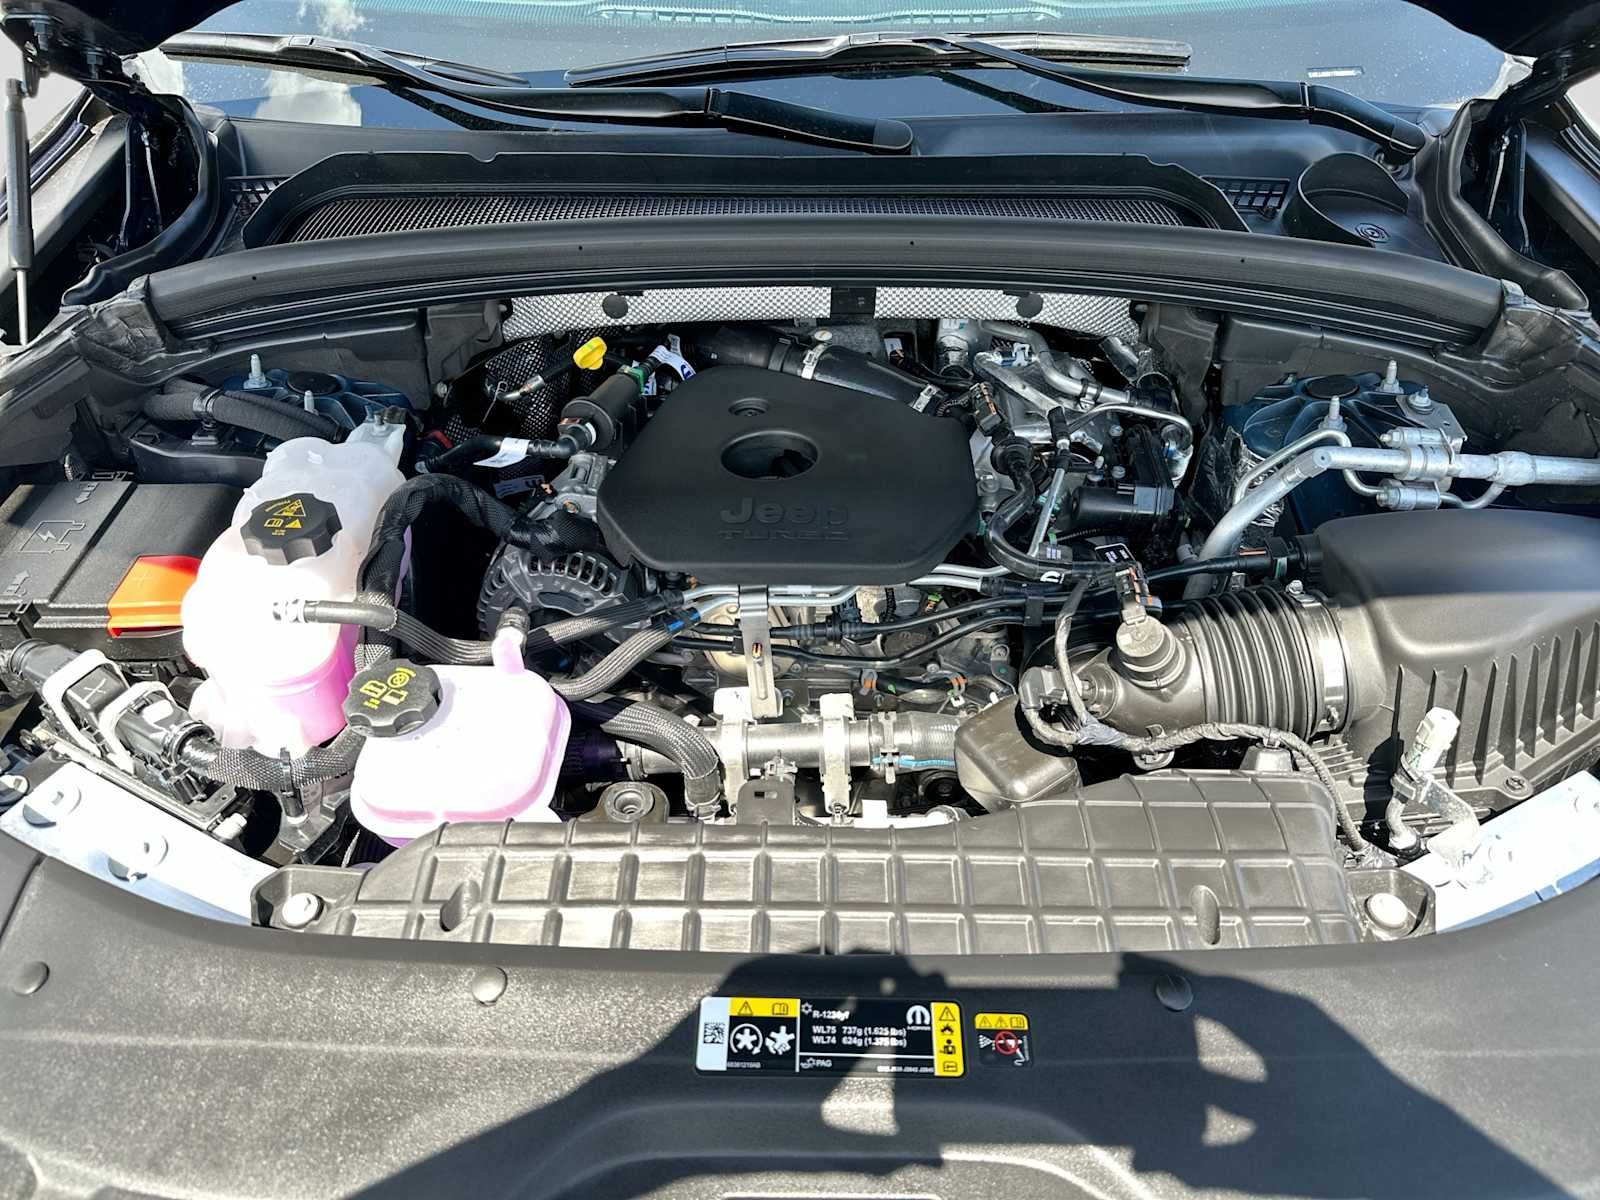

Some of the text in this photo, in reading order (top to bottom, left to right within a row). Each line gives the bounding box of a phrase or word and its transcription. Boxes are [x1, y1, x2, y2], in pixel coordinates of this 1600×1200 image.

[719, 497, 849, 528] Jeep
[812, 1025, 837, 1034] WL75
[842, 1026, 863, 1037] 737g
[864, 1027, 889, 1037] (1.625
[812, 1036, 837, 1045] WL74
[816, 1059, 832, 1068] PAG
